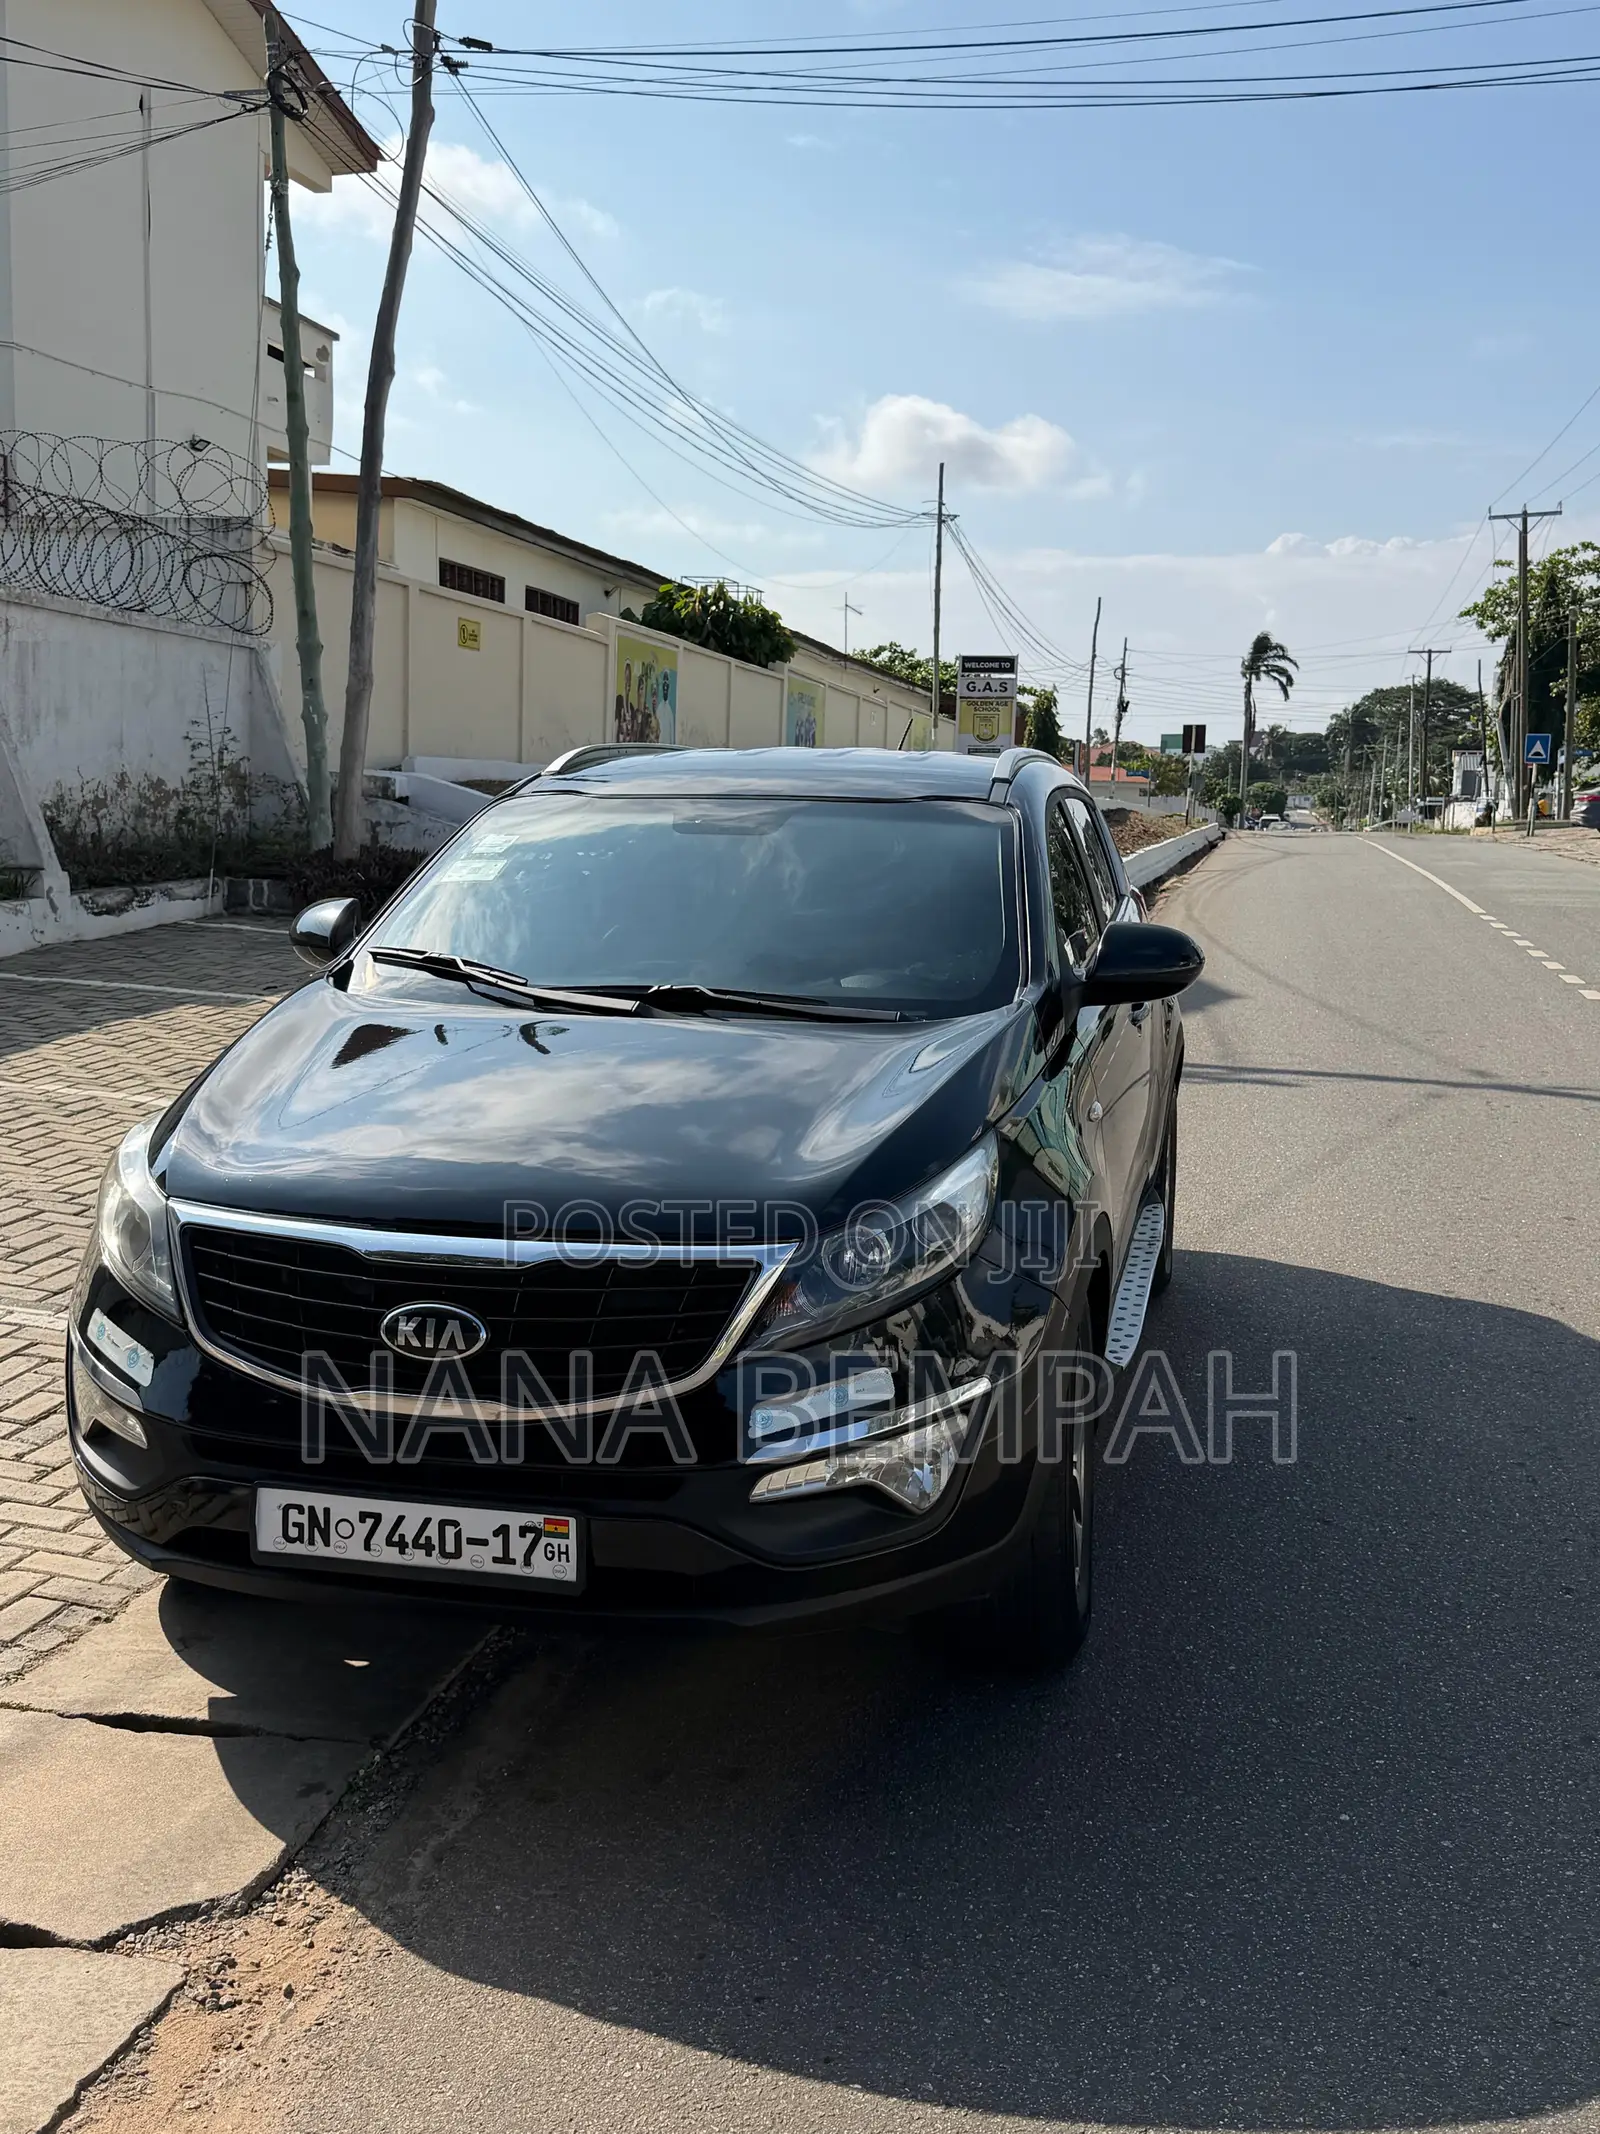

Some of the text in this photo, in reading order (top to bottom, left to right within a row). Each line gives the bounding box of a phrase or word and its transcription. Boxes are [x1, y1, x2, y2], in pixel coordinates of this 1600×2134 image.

[966, 681, 1008, 693] G.A.S
[397, 1316, 466, 1350] KIA
[281, 1503, 543, 1566] GN 7440-17
[544, 1542, 570, 1563] GH
